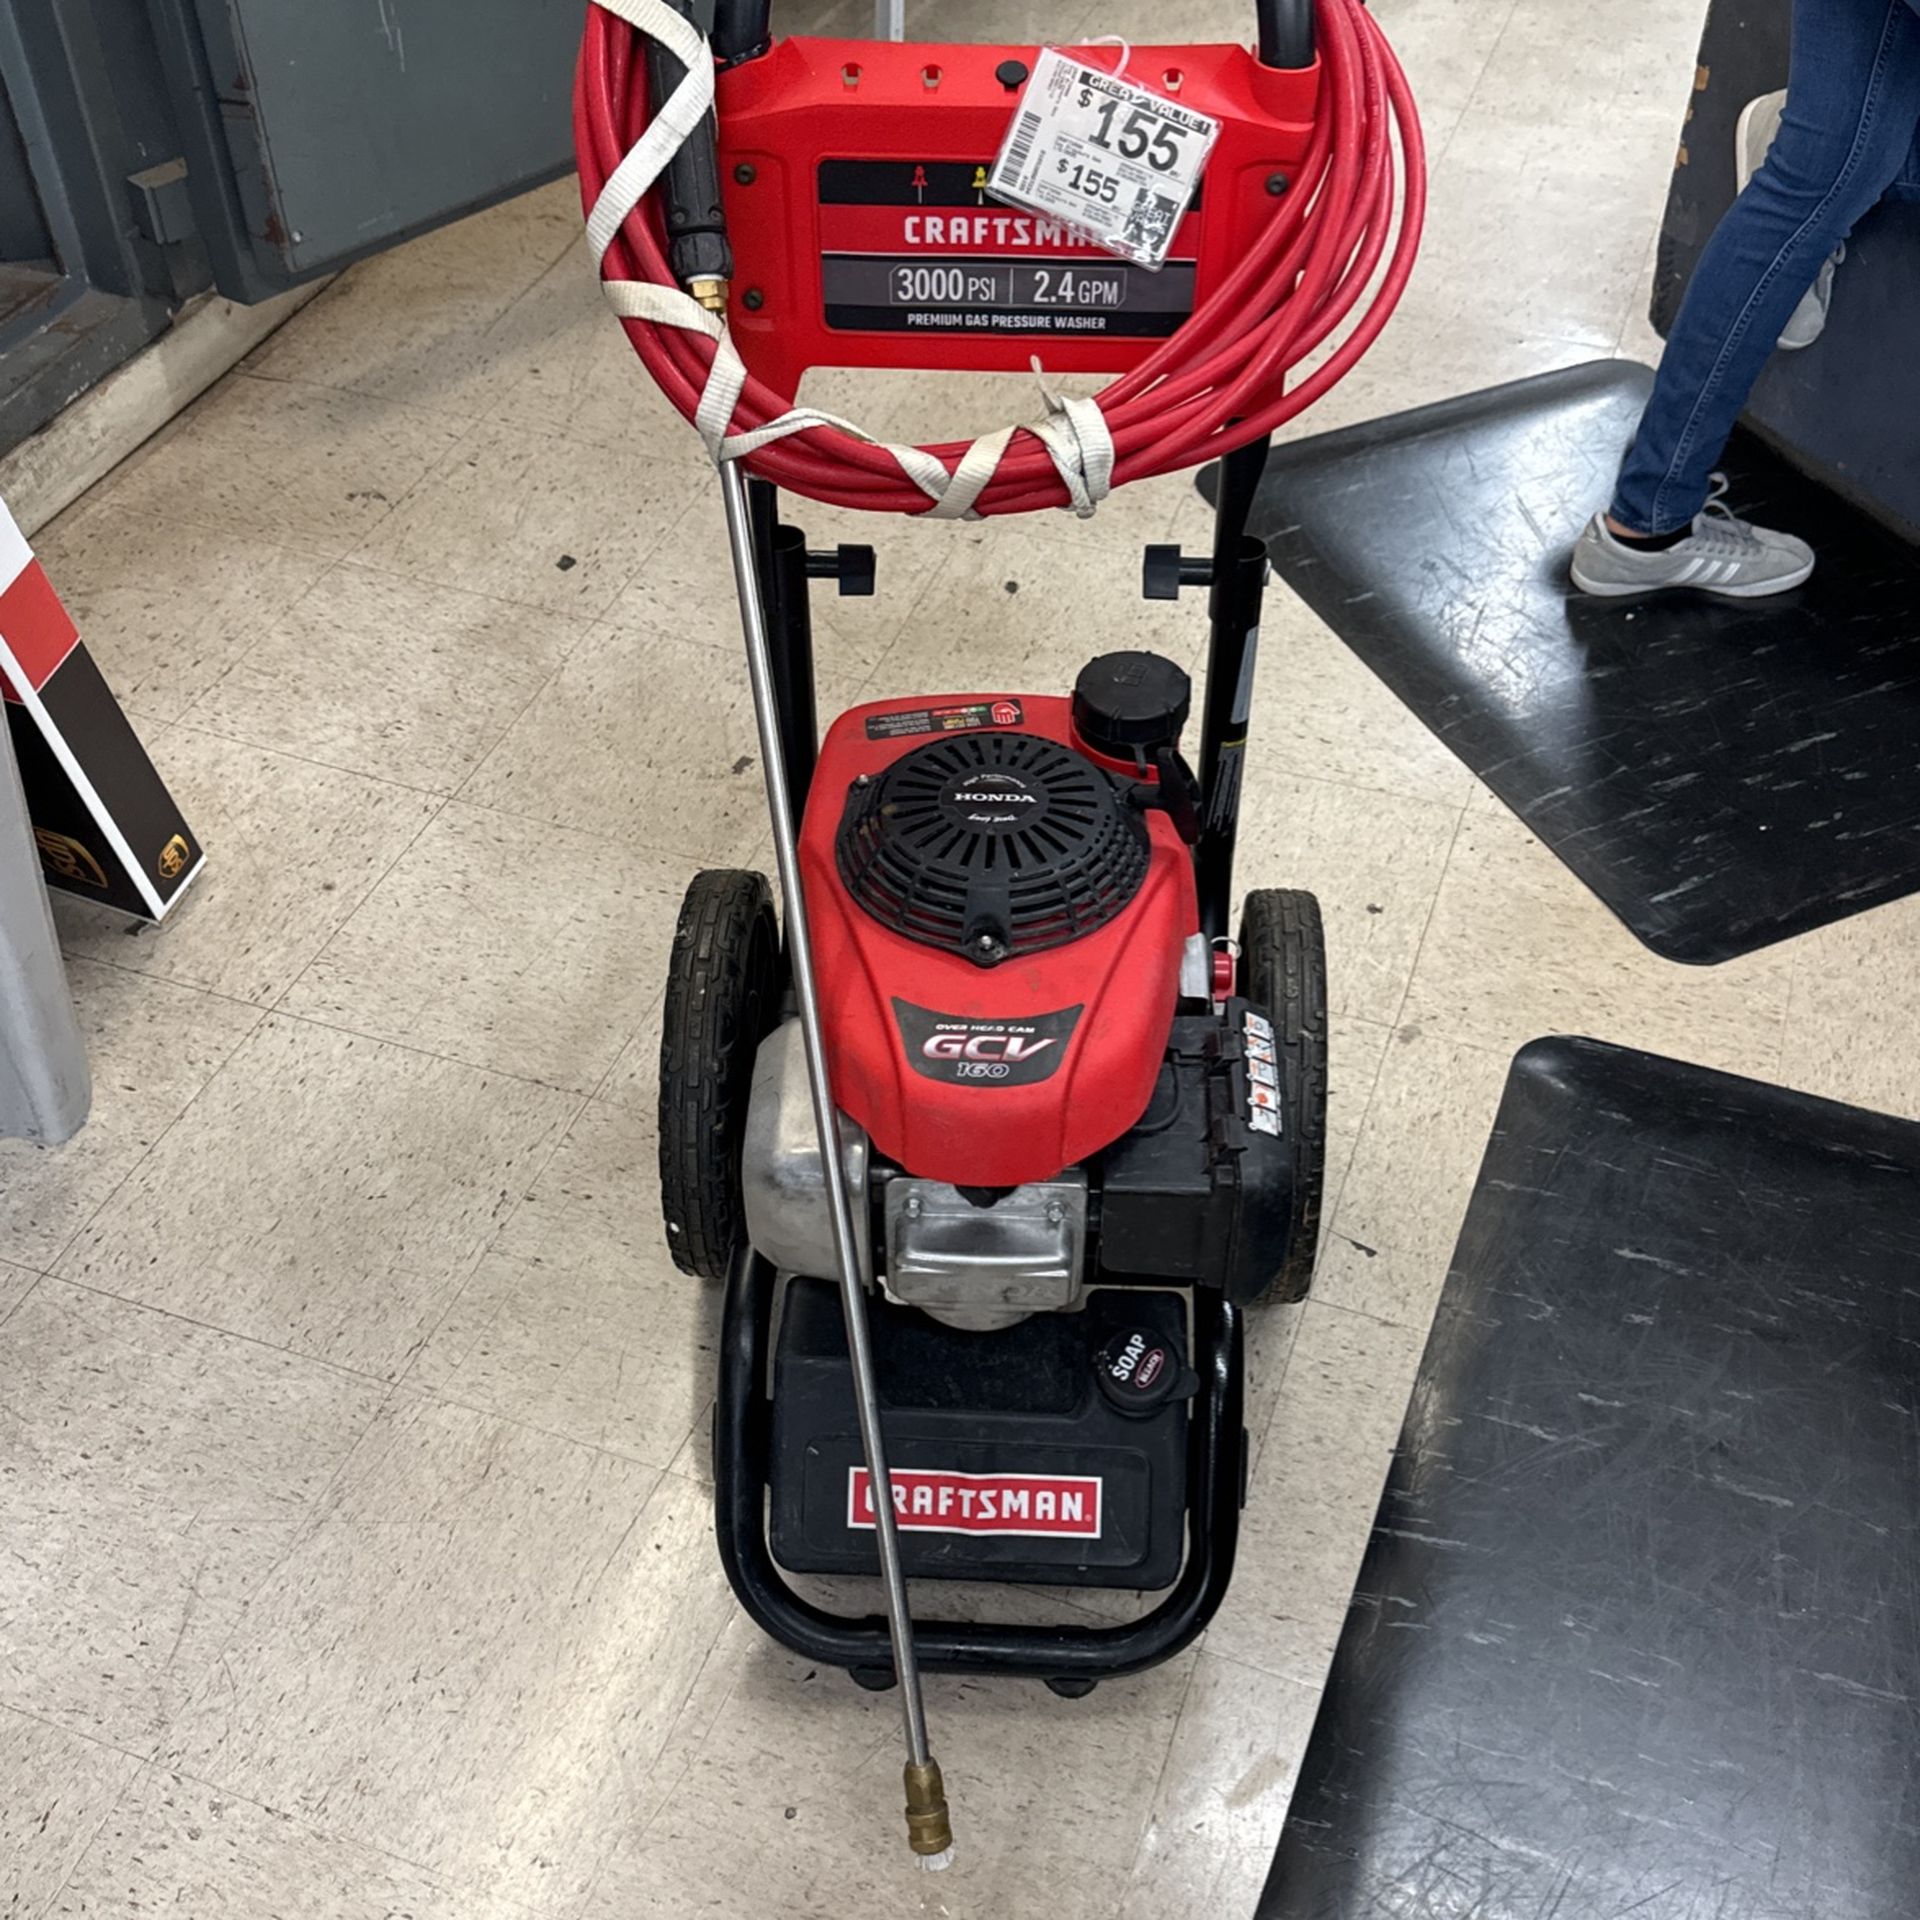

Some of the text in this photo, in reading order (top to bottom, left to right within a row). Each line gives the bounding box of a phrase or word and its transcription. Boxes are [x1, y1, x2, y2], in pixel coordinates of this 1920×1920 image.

[1089, 75, 1147, 105] GREA
[904, 216, 1104, 247] CRAFTSMA
[898, 268, 995, 301] 3000 PSI
[1033, 271, 1118, 304] 2.4 GPM
[907, 313, 1106, 330] PREMIUM GAS PRESSURE WASHER
[954, 792, 1038, 804] HONDA
[935, 1023, 966, 1031] OVER
[1007, 1025, 1035, 1034] CAM
[922, 1033, 1058, 1062] GCV
[956, 1062, 1010, 1078] 160
[1111, 1333, 1146, 1381] SOAP
